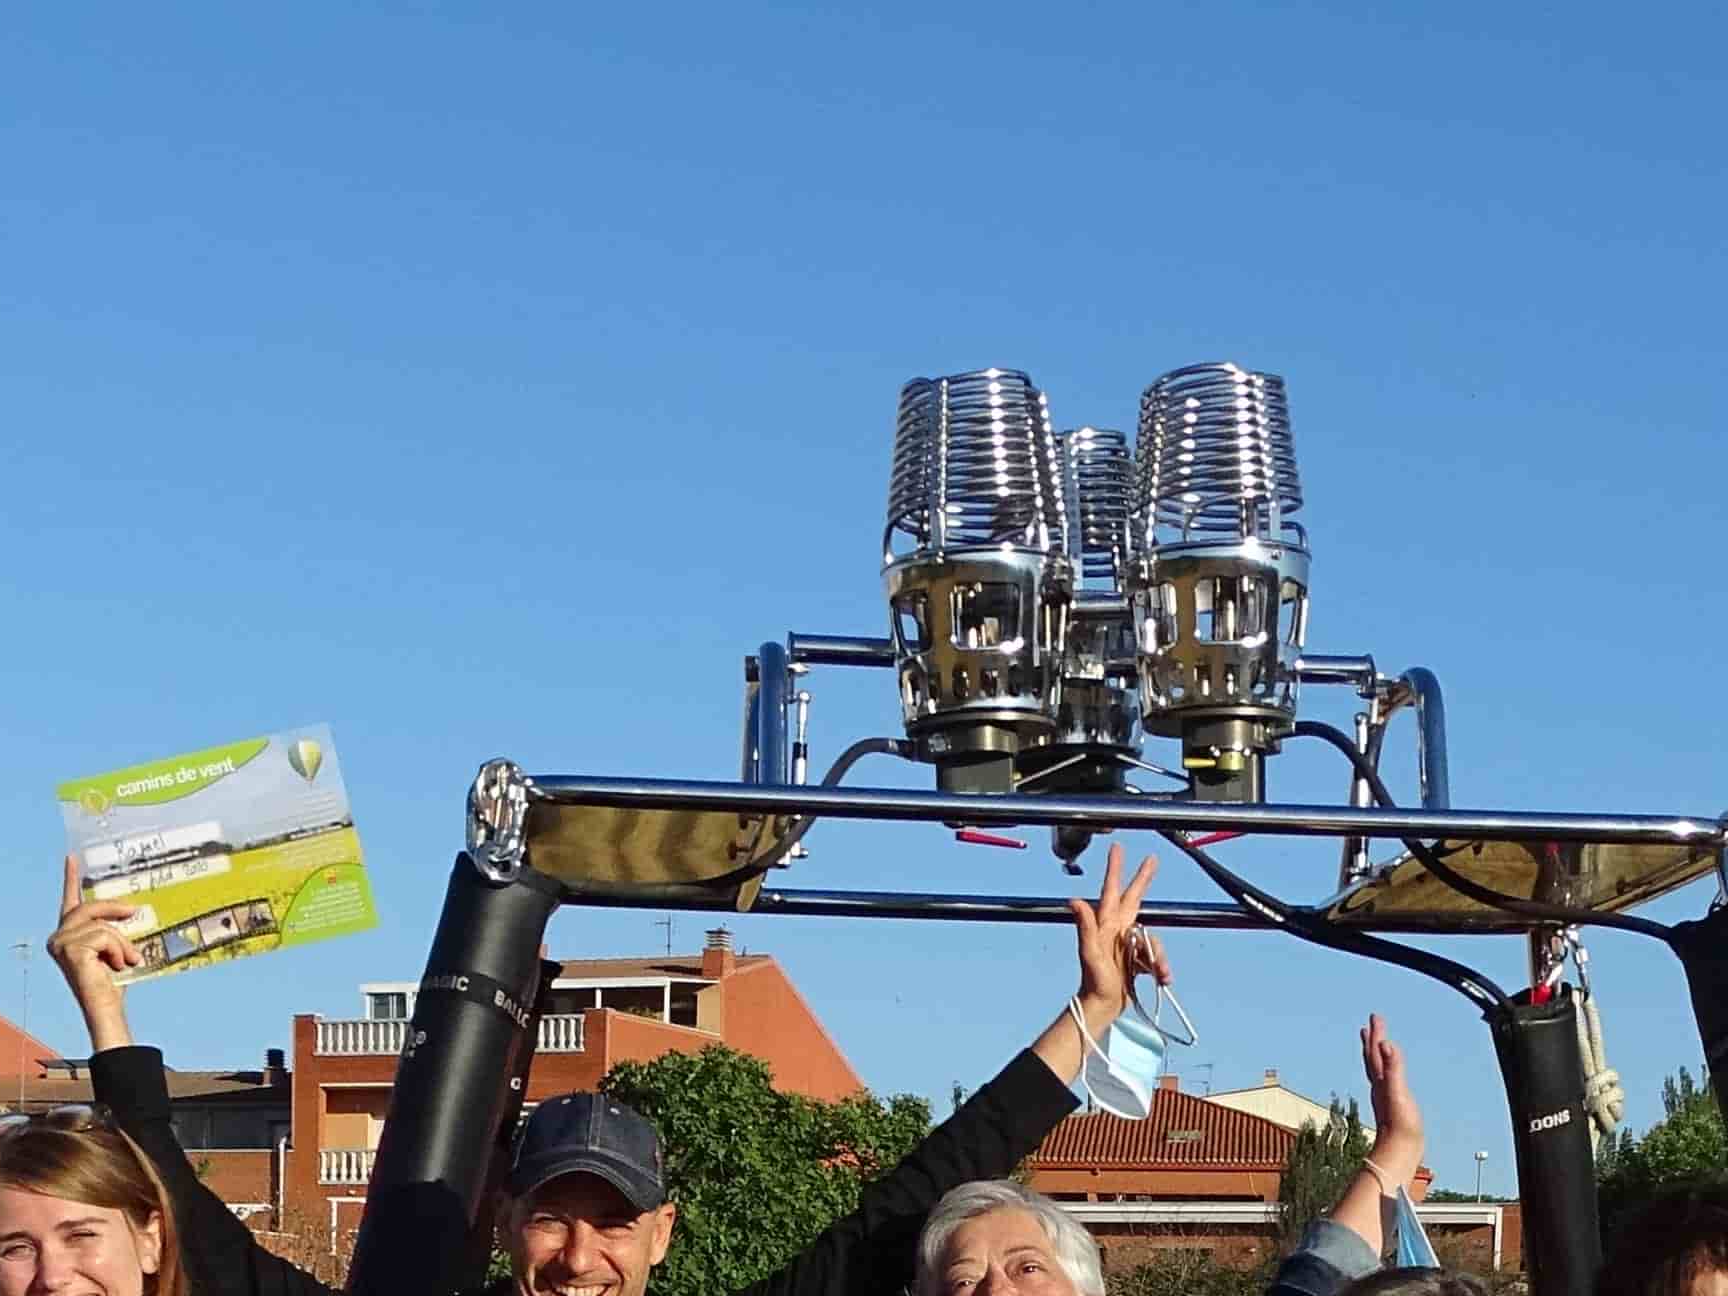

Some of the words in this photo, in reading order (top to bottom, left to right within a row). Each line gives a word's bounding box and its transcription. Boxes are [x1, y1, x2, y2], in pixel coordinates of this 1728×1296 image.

[116, 770, 175, 798] camins
[176, 765, 198, 783] de
[200, 756, 236, 777] vent
